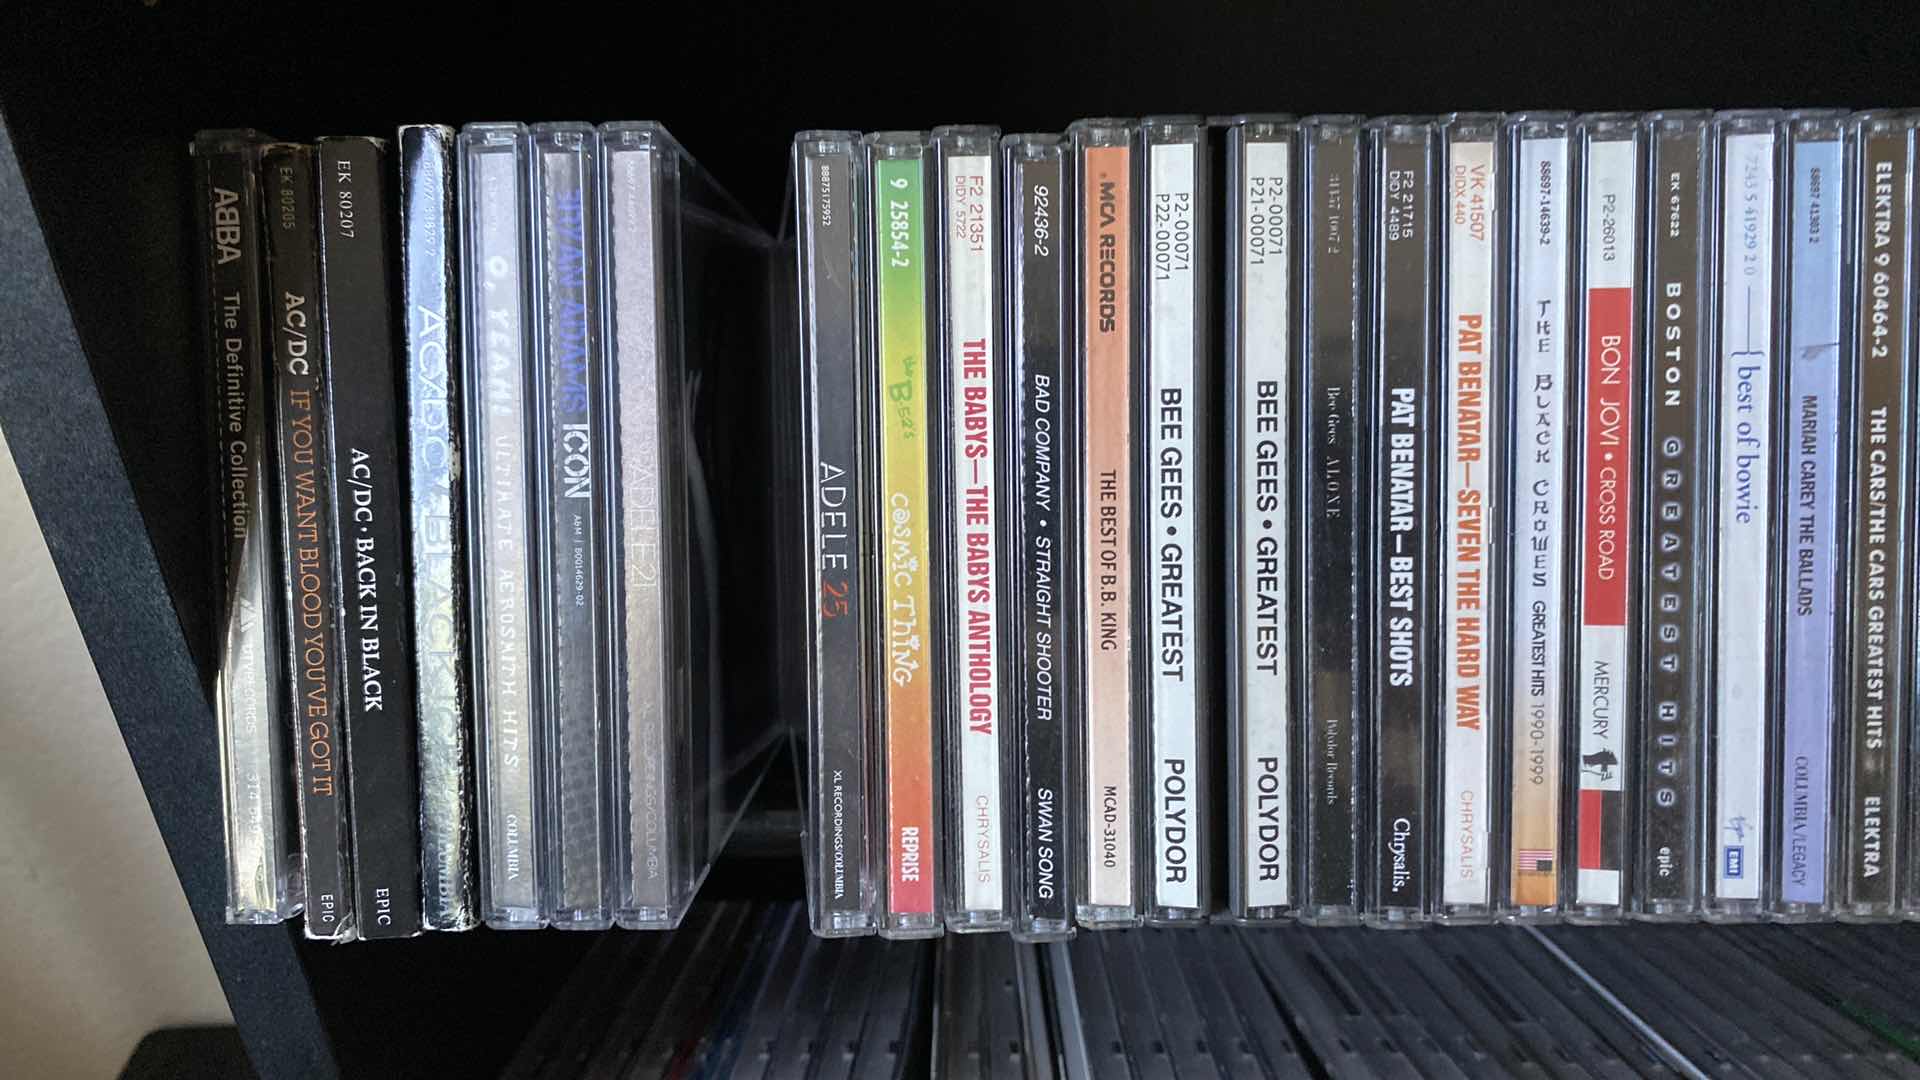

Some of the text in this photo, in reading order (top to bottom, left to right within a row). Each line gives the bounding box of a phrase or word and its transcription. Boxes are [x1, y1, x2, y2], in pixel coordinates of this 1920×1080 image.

[279, 167, 293, 185] EK
[337, 160, 354, 239] EK 80207
[956, 175, 967, 239] DIDY 5722
[970, 175, 985, 252] F2 21351
[1389, 170, 1400, 241] DIDY 4489
[1402, 170, 1413, 238] F2 21715
[1454, 164, 1466, 225] DIDX 440
[1470, 164, 1484, 240] VK 41507
[1670, 172, 1680, 237] EK 67622
[1744, 193, 1758, 202] 5
[889, 178, 909, 268] 9 25854-2
[1033, 184, 1049, 257] 92436-2
[1154, 193, 1170, 281] P22-00071
[1175, 192, 1189, 271] P2-00071
[1250, 177, 1265, 266] P21-00071
[1269, 177, 1283, 255] P2-00071
[1601, 194, 1616, 262] P2-26013
[1743, 206, 1758, 249] 41929
[1099, 181, 1116, 333] MCA RECORDS
[1743, 254, 1757, 262] 2
[1743, 265, 1757, 276] 0
[1871, 161, 1893, 359] ELEKTRA 9 60464-2
[214, 187, 250, 538] ABBA The Definitive Collection
[486, 308, 512, 416] YEAH!
[557, 300, 589, 412] ADAMS
[963, 338, 988, 379] THE
[1458, 314, 1482, 354] PAT
[1537, 300, 1551, 353] THE
[418, 305, 450, 470] AC/DC
[1327, 387, 1341, 411] Bee
[1391, 388, 1414, 428] PAT
[562, 423, 591, 499] ICON
[1327, 413, 1341, 445] Gees
[1598, 335, 1621, 581] BON JOVI CROSS ROAD
[1735, 366, 1761, 524] best of bowie
[494, 434, 516, 551] ULTIMATE
[1256, 381, 1278, 676] BEE GEES GREATEST
[1797, 395, 1818, 617] MARIAH CAREY THE BALLADS
[283, 291, 333, 796] AC/DC IF YOU WANT BLOOD YOU'VE GOT IT
[819, 461, 849, 618] ADELE 25
[967, 532, 991, 603] BABYS
[1035, 374, 1053, 721] BAD COMPANY STRAIGHT SHOOTER
[1100, 469, 1117, 651] THE BEST OF B.B. KING
[1160, 388, 1184, 682] BEE GEES GREATEST
[1658, 282, 1681, 806] BOSTON GREATEST HITS
[347, 447, 383, 712] AC/DC BACK IN BLACK
[1457, 568, 1480, 610] THE
[1866, 406, 1887, 749] THE CARS/THE CARS GREATEST HITS
[498, 569, 517, 695] AEROSMITH
[1388, 616, 1413, 686] SHOTS
[1457, 616, 1480, 678] HARD
[1531, 600, 1546, 667] GREATEST
[967, 610, 992, 736] ANTHOLOGY
[1456, 685, 1481, 731] WAY
[1531, 669, 1546, 697] HITS
[1591, 660, 1609, 740] MERCURY
[501, 710, 519, 768] HITS
[1529, 702, 1544, 786] 1990-1999
[1164, 758, 1187, 884] POLYDOR
[1257, 757, 1280, 882] POLYDOR
[1326, 762, 1338, 805] Records
[1791, 755, 1809, 886] COLUMBIA/LEGACY
[506, 814, 519, 881] COLUMBIA
[831, 769, 845, 900] XL RECORDINGS/COLUMBIA
[900, 826, 920, 882] REPRISE
[975, 795, 991, 884] CHRYSALIS
[1037, 787, 1055, 899] SWAN SONG
[1103, 786, 1117, 868] MCAD-31040
[1460, 790, 1474, 878] CHRYSALIS
[1657, 846, 1674, 877] epic
[1728, 850, 1740, 874] EMI
[1863, 796, 1881, 878] ELEKTRA
[321, 894, 335, 923] EPIC
[376, 888, 391, 926] EPIC
